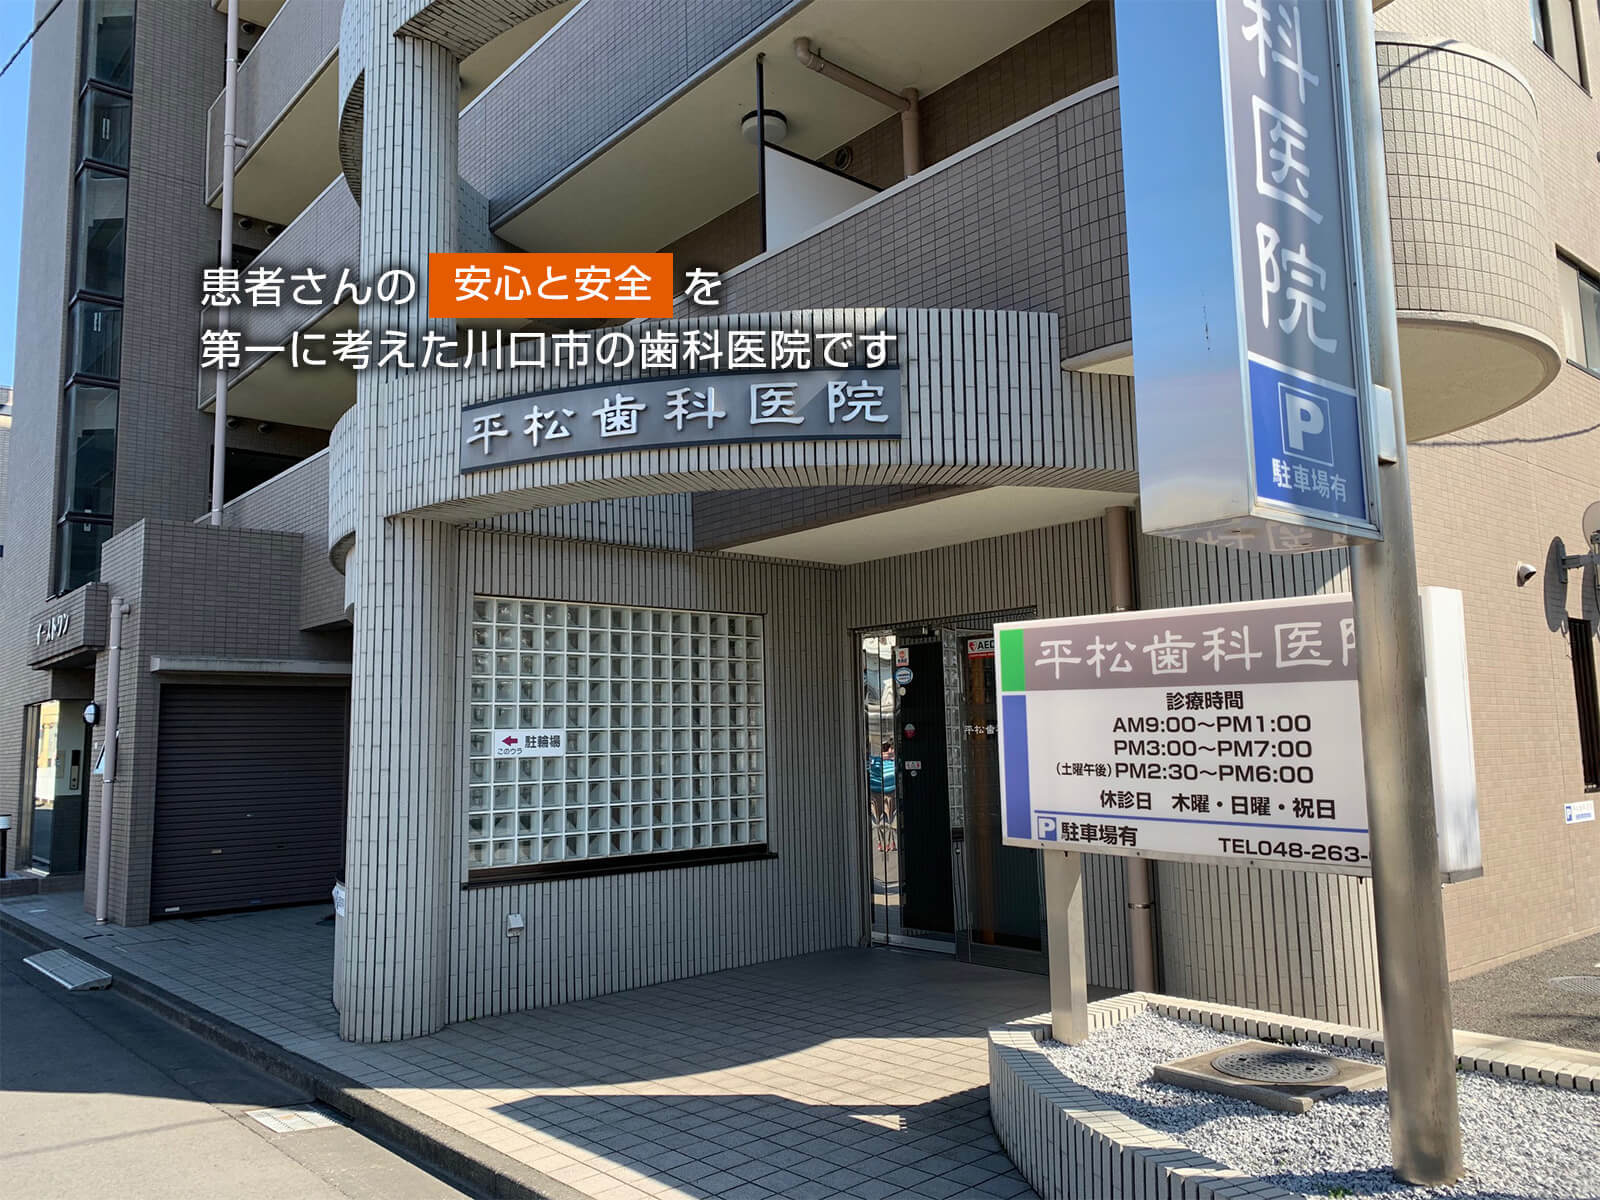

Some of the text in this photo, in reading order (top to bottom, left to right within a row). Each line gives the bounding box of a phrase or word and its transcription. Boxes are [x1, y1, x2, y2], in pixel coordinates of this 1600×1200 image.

[466, 379, 890, 455] 平松歯科医院
[1285, 392, 1324, 451] P
[1271, 457, 1347, 503] 駐車場有
[1166, 690, 1244, 711] 診療時間
[525, 735, 561, 748] 駐輪場
[1100, 790, 1337, 820] 休診日 木曜・日曜・祝日
[1061, 822, 1138, 847] 駐車場有
[1218, 837, 1371, 864] TEL048-263-
